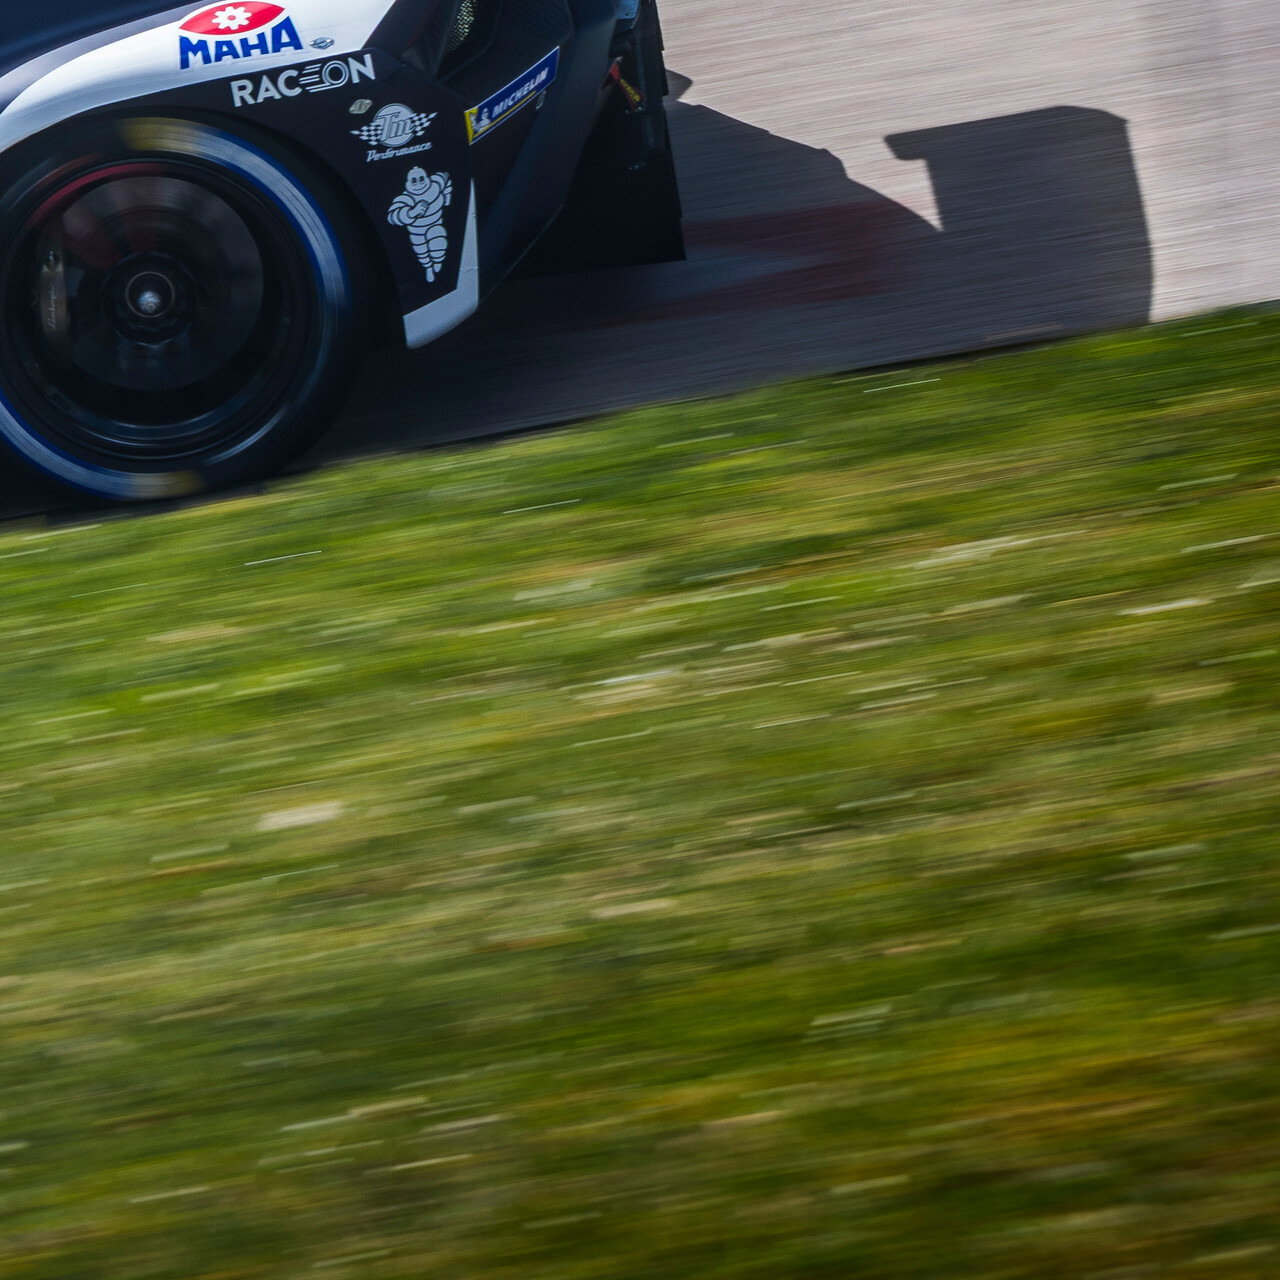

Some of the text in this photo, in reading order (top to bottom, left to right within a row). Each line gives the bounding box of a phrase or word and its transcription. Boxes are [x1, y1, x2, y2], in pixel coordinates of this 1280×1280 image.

[179, 16, 303, 70] MAHA
[492, 67, 549, 118] MICHELIN
[366, 142, 432, 162] Performance
